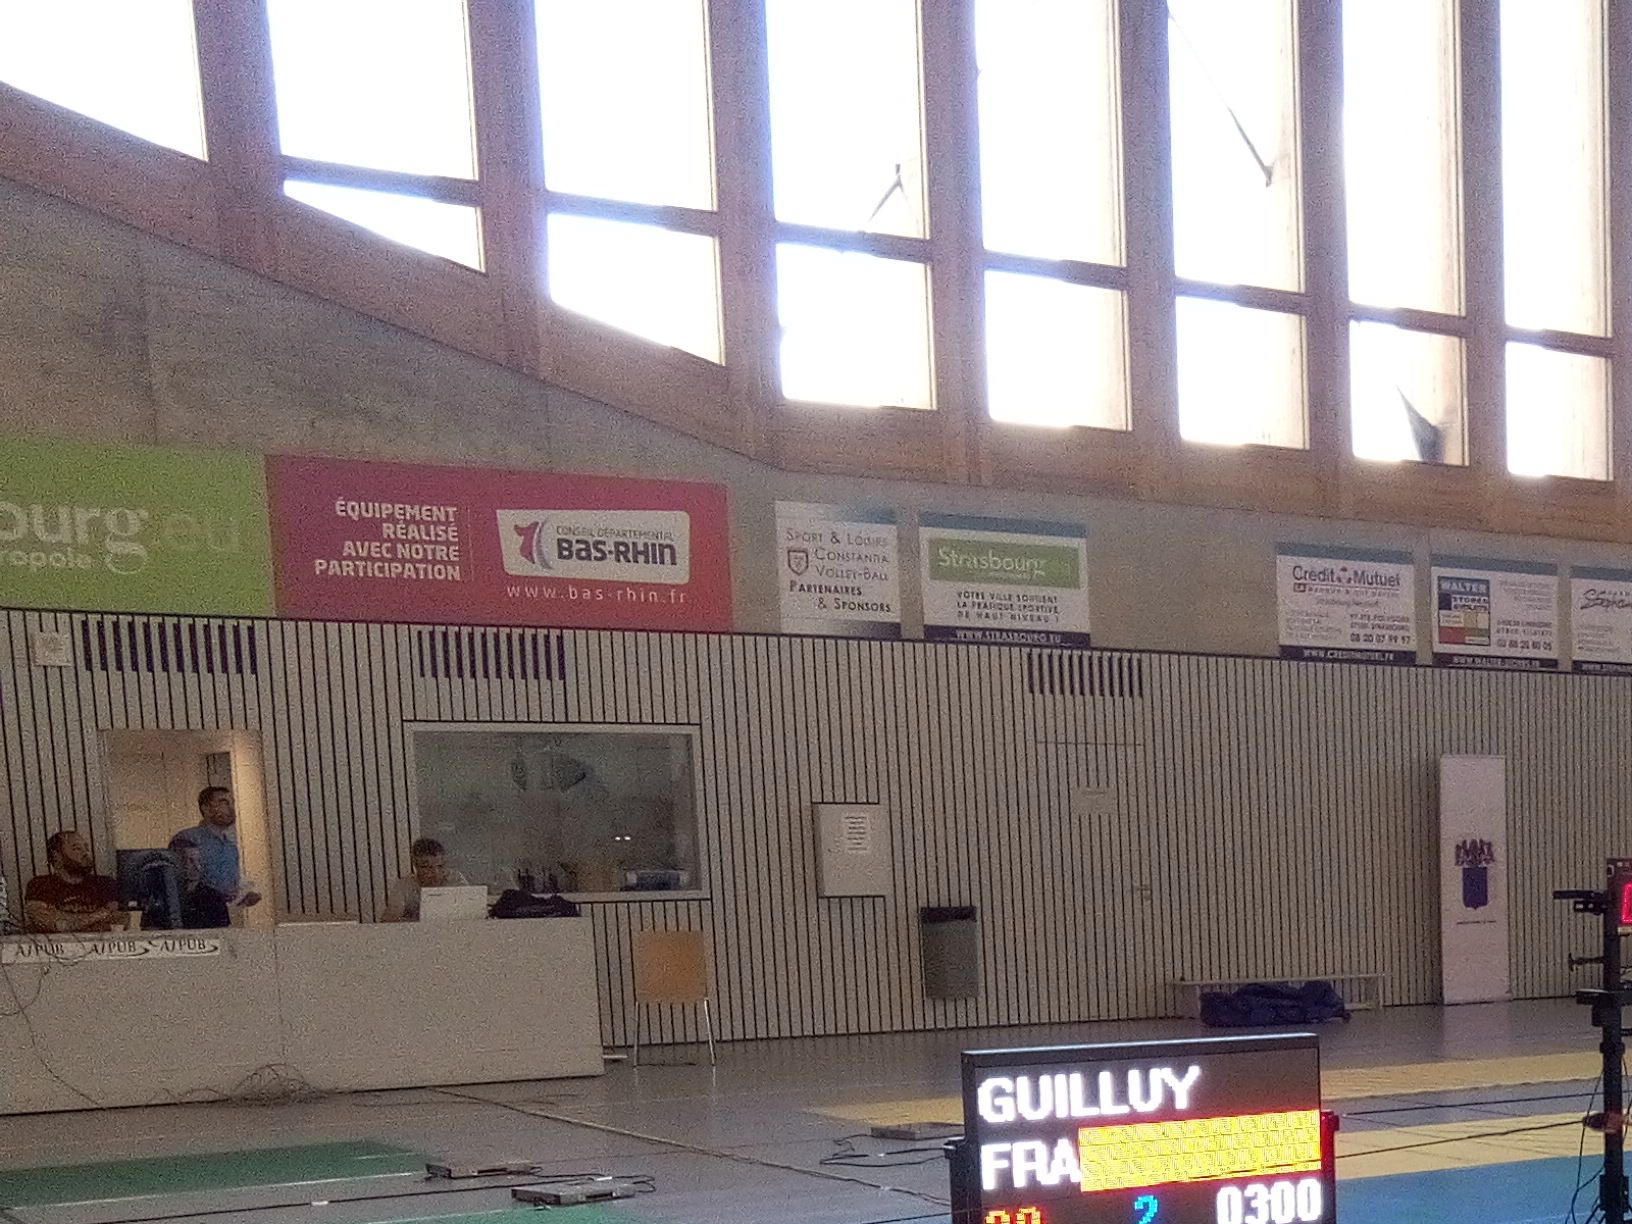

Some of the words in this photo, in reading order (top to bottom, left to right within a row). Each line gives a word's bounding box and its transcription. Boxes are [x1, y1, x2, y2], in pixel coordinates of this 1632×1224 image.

[335, 497, 457, 521] ÉQUIPEMENT
[382, 520, 459, 542] RÉALISÉ
[556, 525, 595, 538] CONSEIL
[831, 531, 841, 544] &
[342, 541, 393, 558] AVEC
[397, 543, 460, 561] NOTRE
[314, 559, 460, 581] PARTICIPATION
[1353, 570, 1400, 586] Mutuel
[507, 585, 689, 604] www.bas-rhin.fr
[1441, 580, 1488, 593] WALTER
[818, 597, 827, 610] &
[977, 1065, 1201, 1123] GUILLUY
[980, 1138, 1081, 1191] FRA
